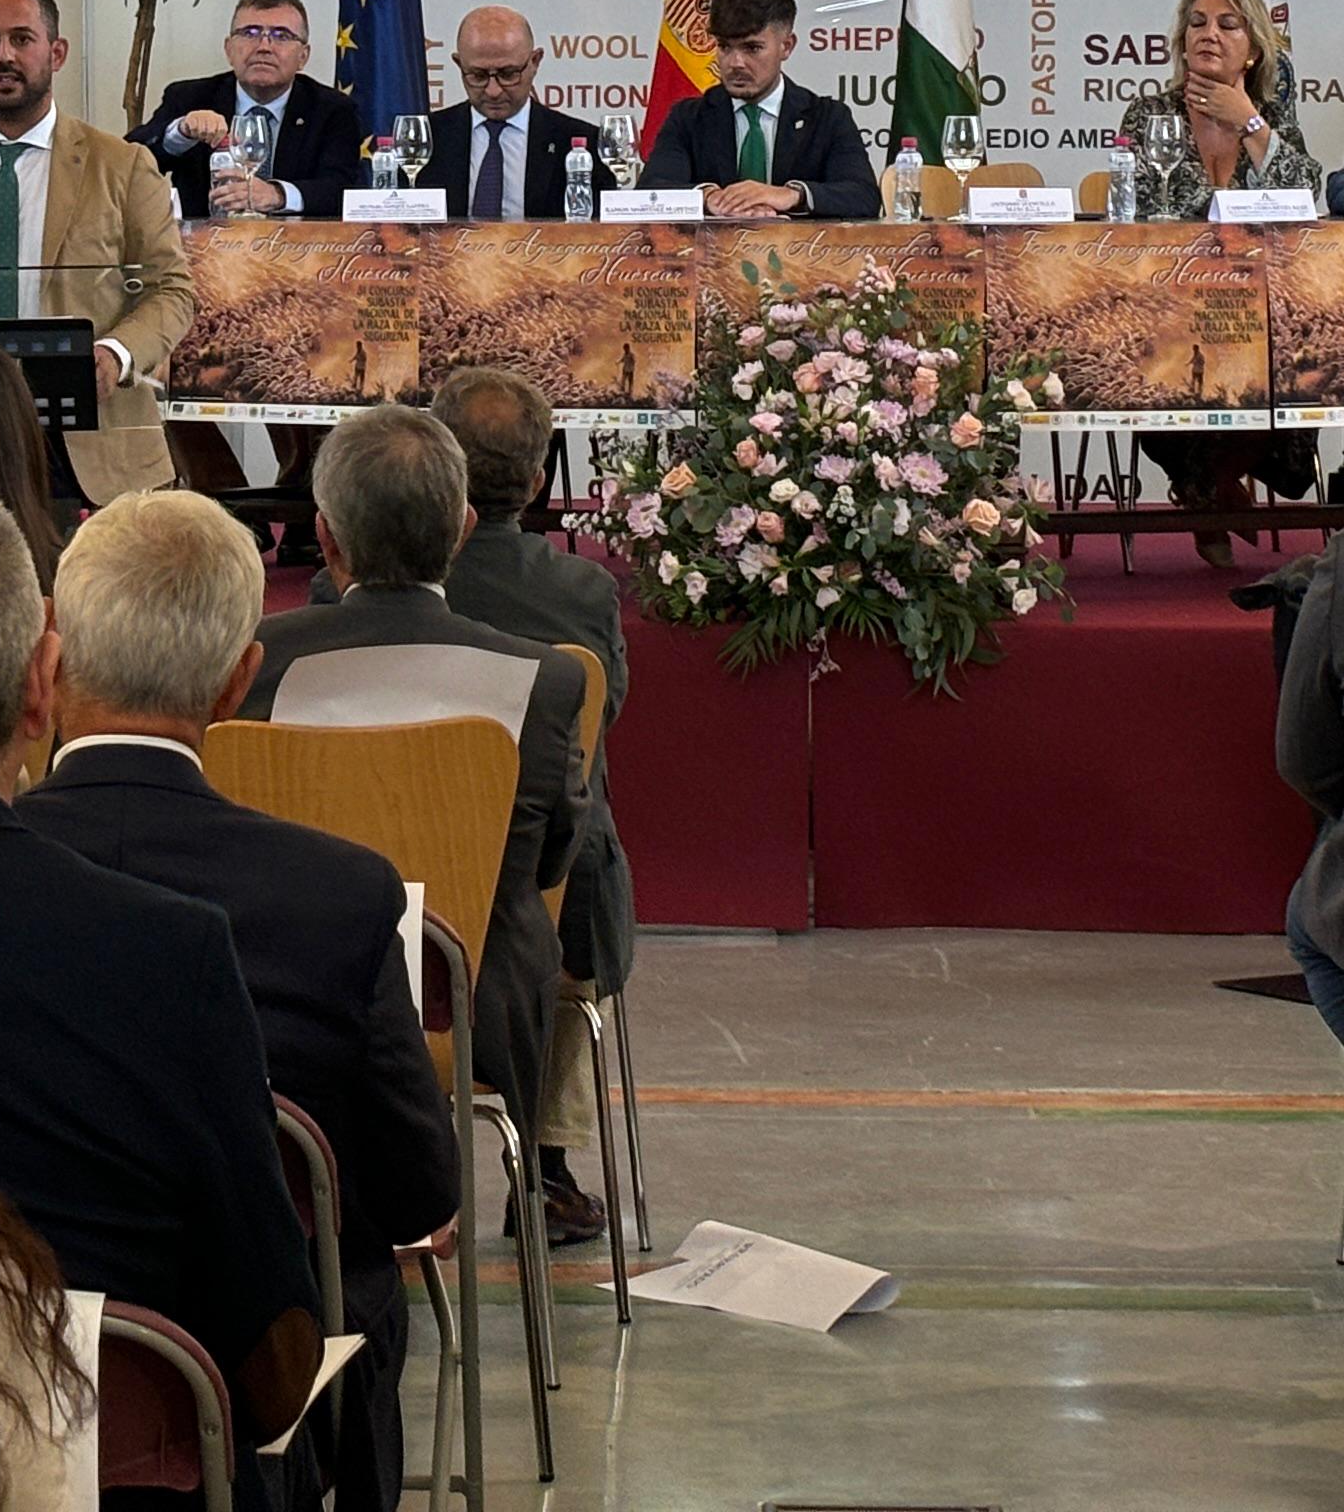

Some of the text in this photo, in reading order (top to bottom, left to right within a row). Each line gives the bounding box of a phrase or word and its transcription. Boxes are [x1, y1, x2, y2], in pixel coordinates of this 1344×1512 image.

[551, 35, 648, 59] WOOL
[1083, 34, 1171, 66] SAB
[987, 129, 1117, 149] EDIO AMB
[1065, 474, 1142, 501] DAD
